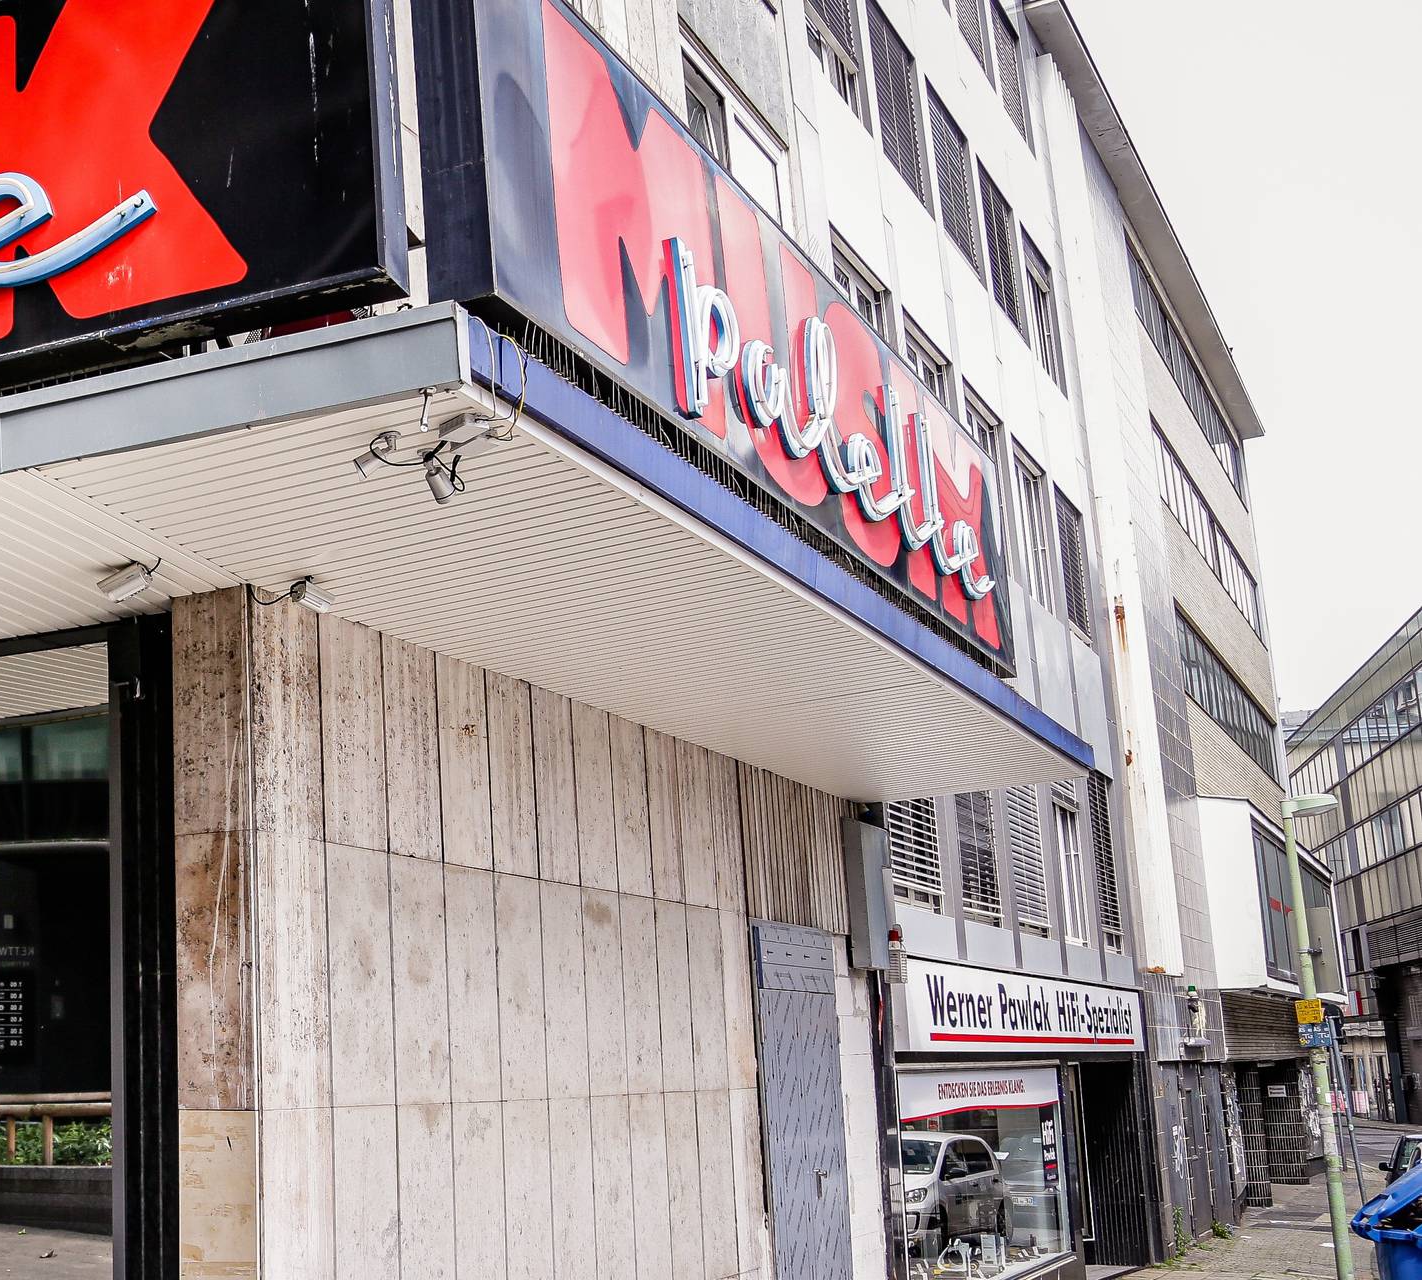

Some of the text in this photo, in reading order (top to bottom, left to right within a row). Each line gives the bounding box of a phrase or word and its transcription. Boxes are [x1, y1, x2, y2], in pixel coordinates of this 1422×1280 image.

[541, 0, 1002, 650] MUSIK
[662, 236, 996, 601] palette
[925, 973, 1133, 1044] Werner Pawlak HiFi-Spezialist
[938, 1083, 969, 1100] ENTDECKEN
[968, 1081, 977, 1097] SIE
[977, 1081, 988, 1097] DAS
[987, 1080, 1009, 1096] ERLEBNIS
